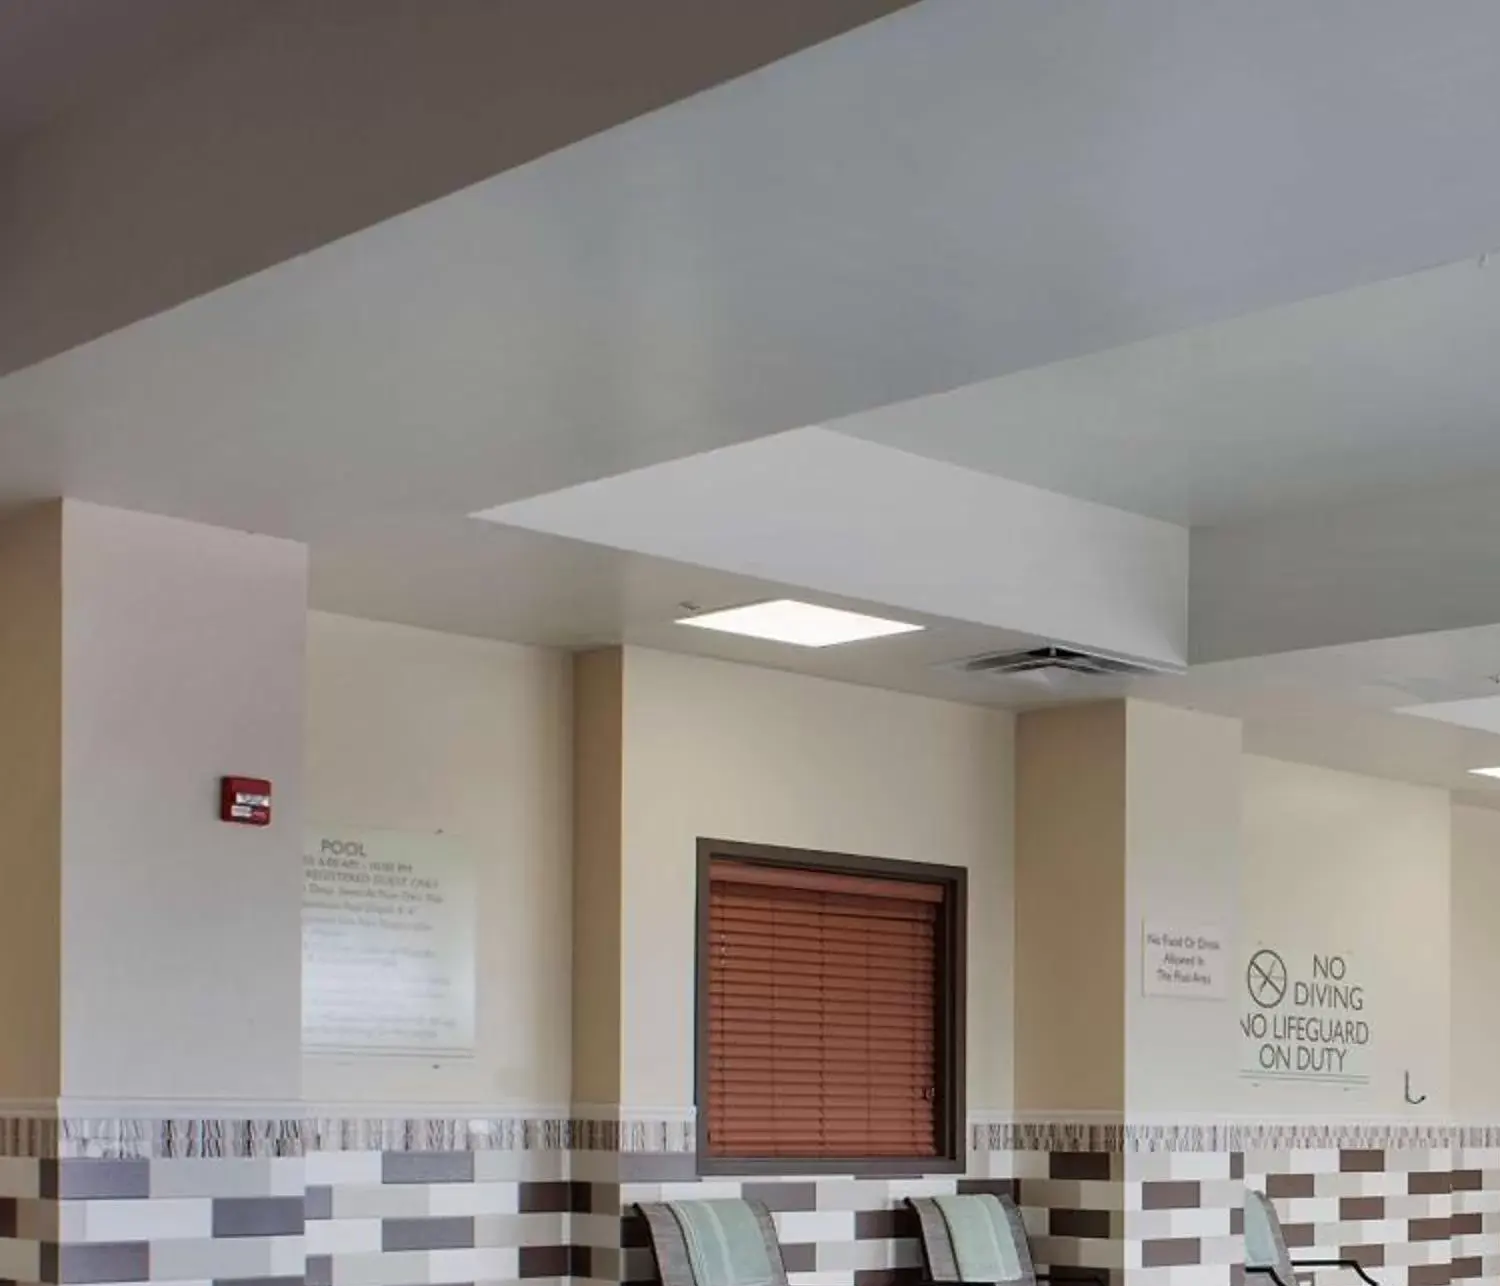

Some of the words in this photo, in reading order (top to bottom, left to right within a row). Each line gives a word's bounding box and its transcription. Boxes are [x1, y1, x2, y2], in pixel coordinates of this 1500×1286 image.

[320, 838, 367, 858] POOL
[1184, 936, 1196, 949] Or
[1312, 954, 1346, 981] NO
[1294, 982, 1364, 1011] DIVING
[1240, 1013, 1267, 1039] NO
[1273, 1015, 1369, 1045] LIFEGUARD
[1259, 1043, 1290, 1070] ON
[1297, 1047, 1348, 1072] DUTY
